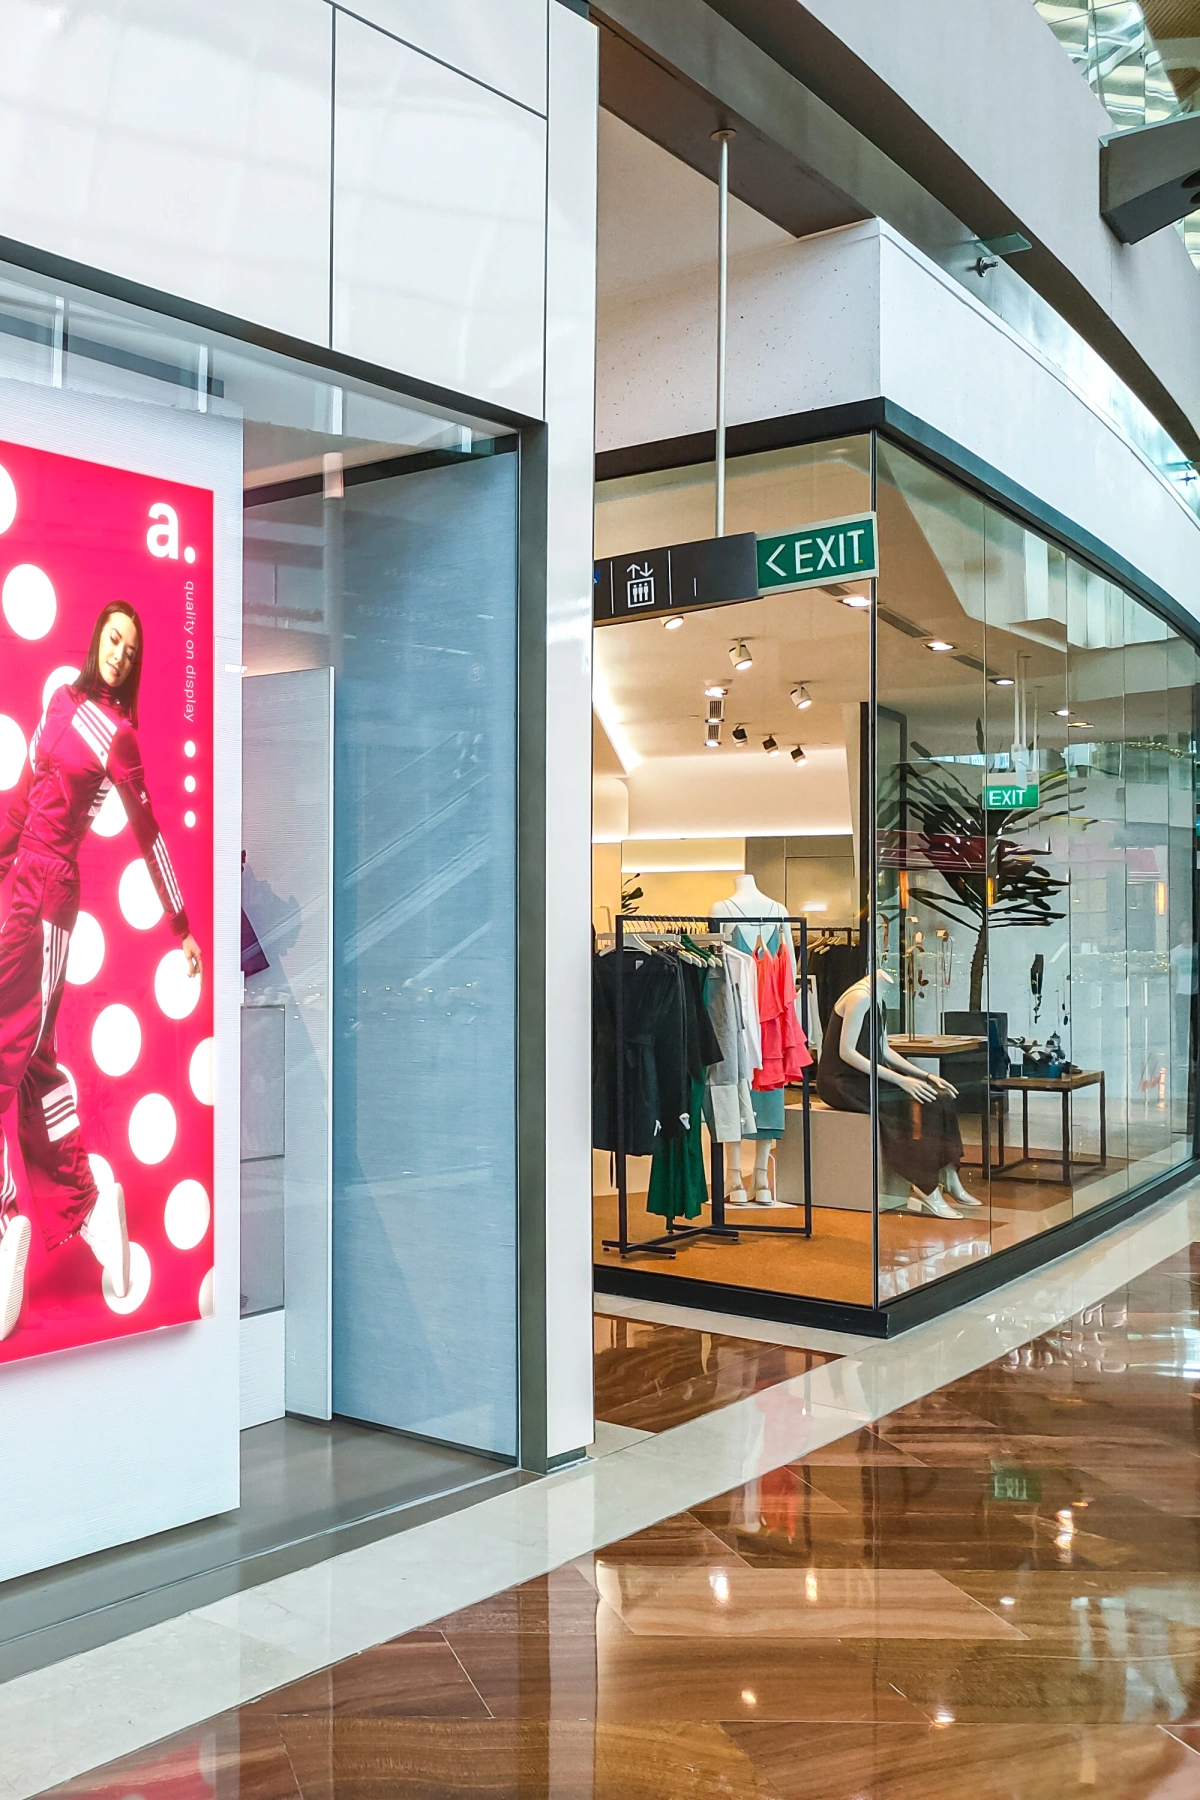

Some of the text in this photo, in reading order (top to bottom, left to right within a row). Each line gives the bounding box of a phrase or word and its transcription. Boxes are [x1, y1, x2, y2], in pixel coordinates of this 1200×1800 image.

[795, 529, 865, 575] EXIT
[183, 580, 196, 723] quality on display
[988, 789, 1026, 806] EXIT
